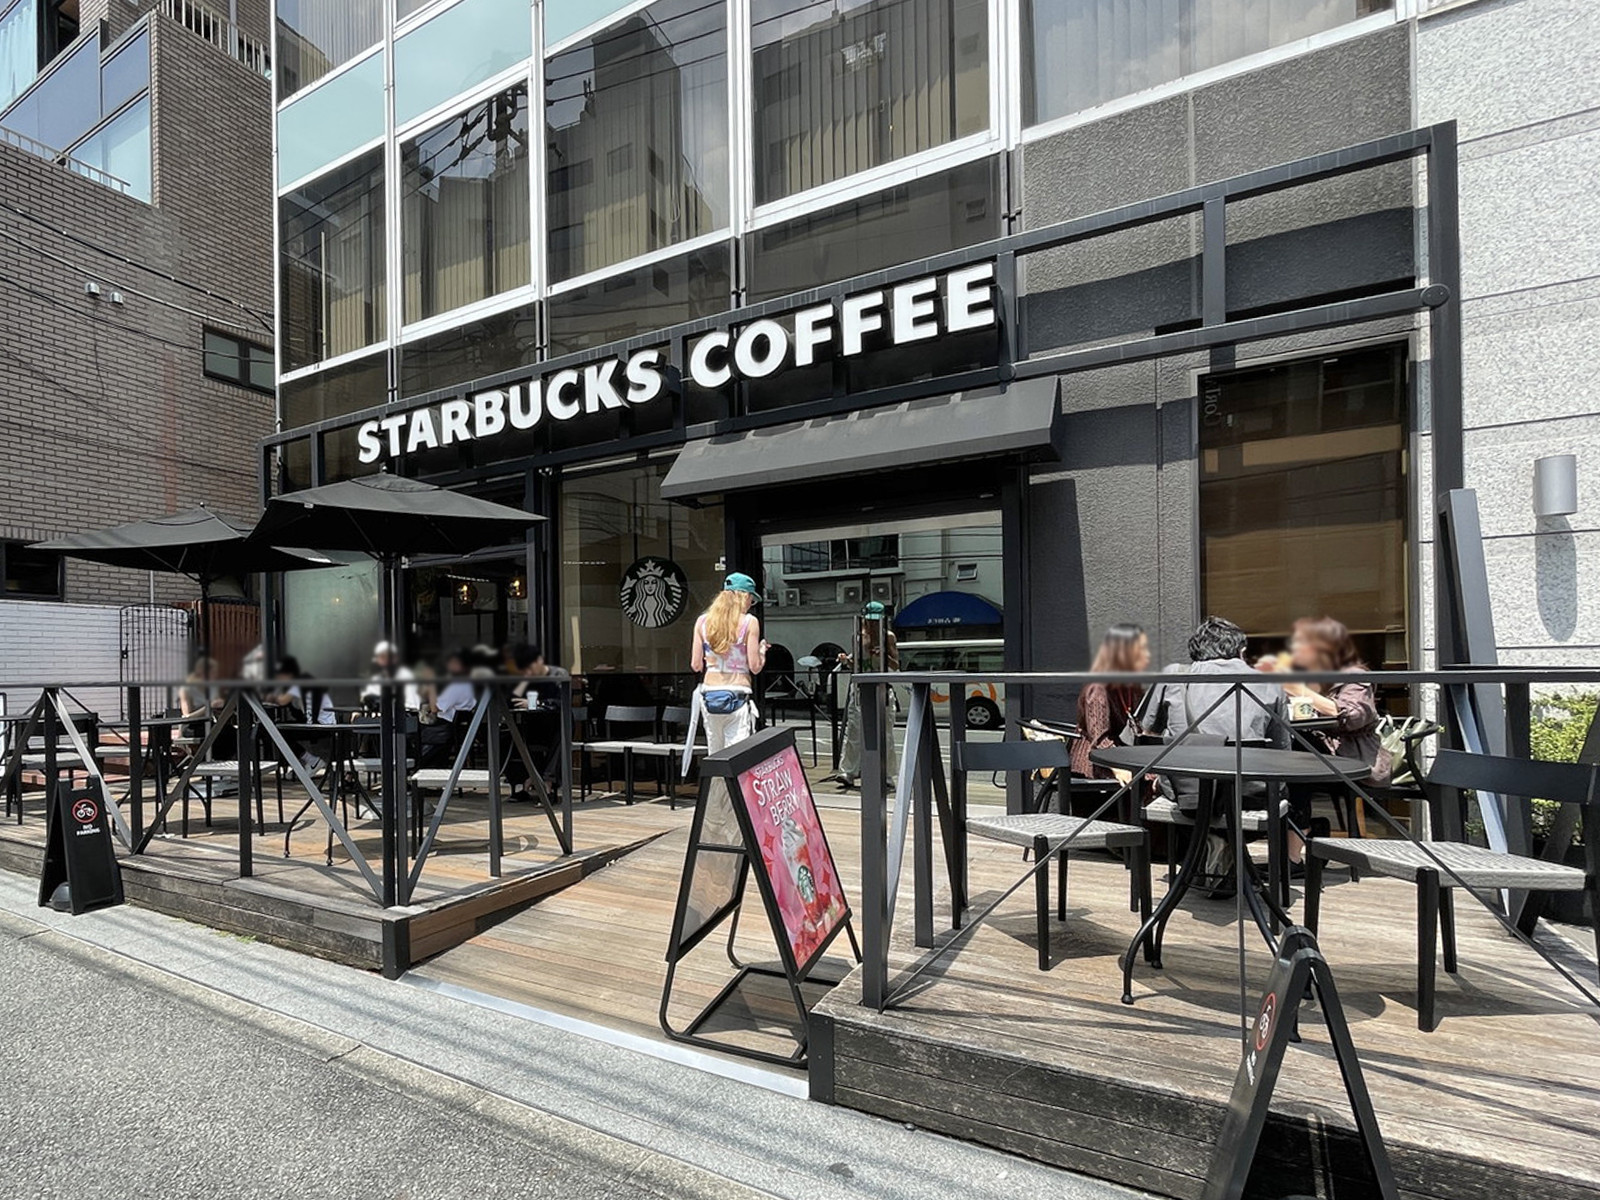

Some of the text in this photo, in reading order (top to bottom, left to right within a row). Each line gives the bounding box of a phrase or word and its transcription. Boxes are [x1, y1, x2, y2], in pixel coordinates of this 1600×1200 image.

[357, 261, 996, 464] STARBUCKS COFFEE
[753, 769, 793, 806] STRAW
[770, 788, 799, 826] BERRY
